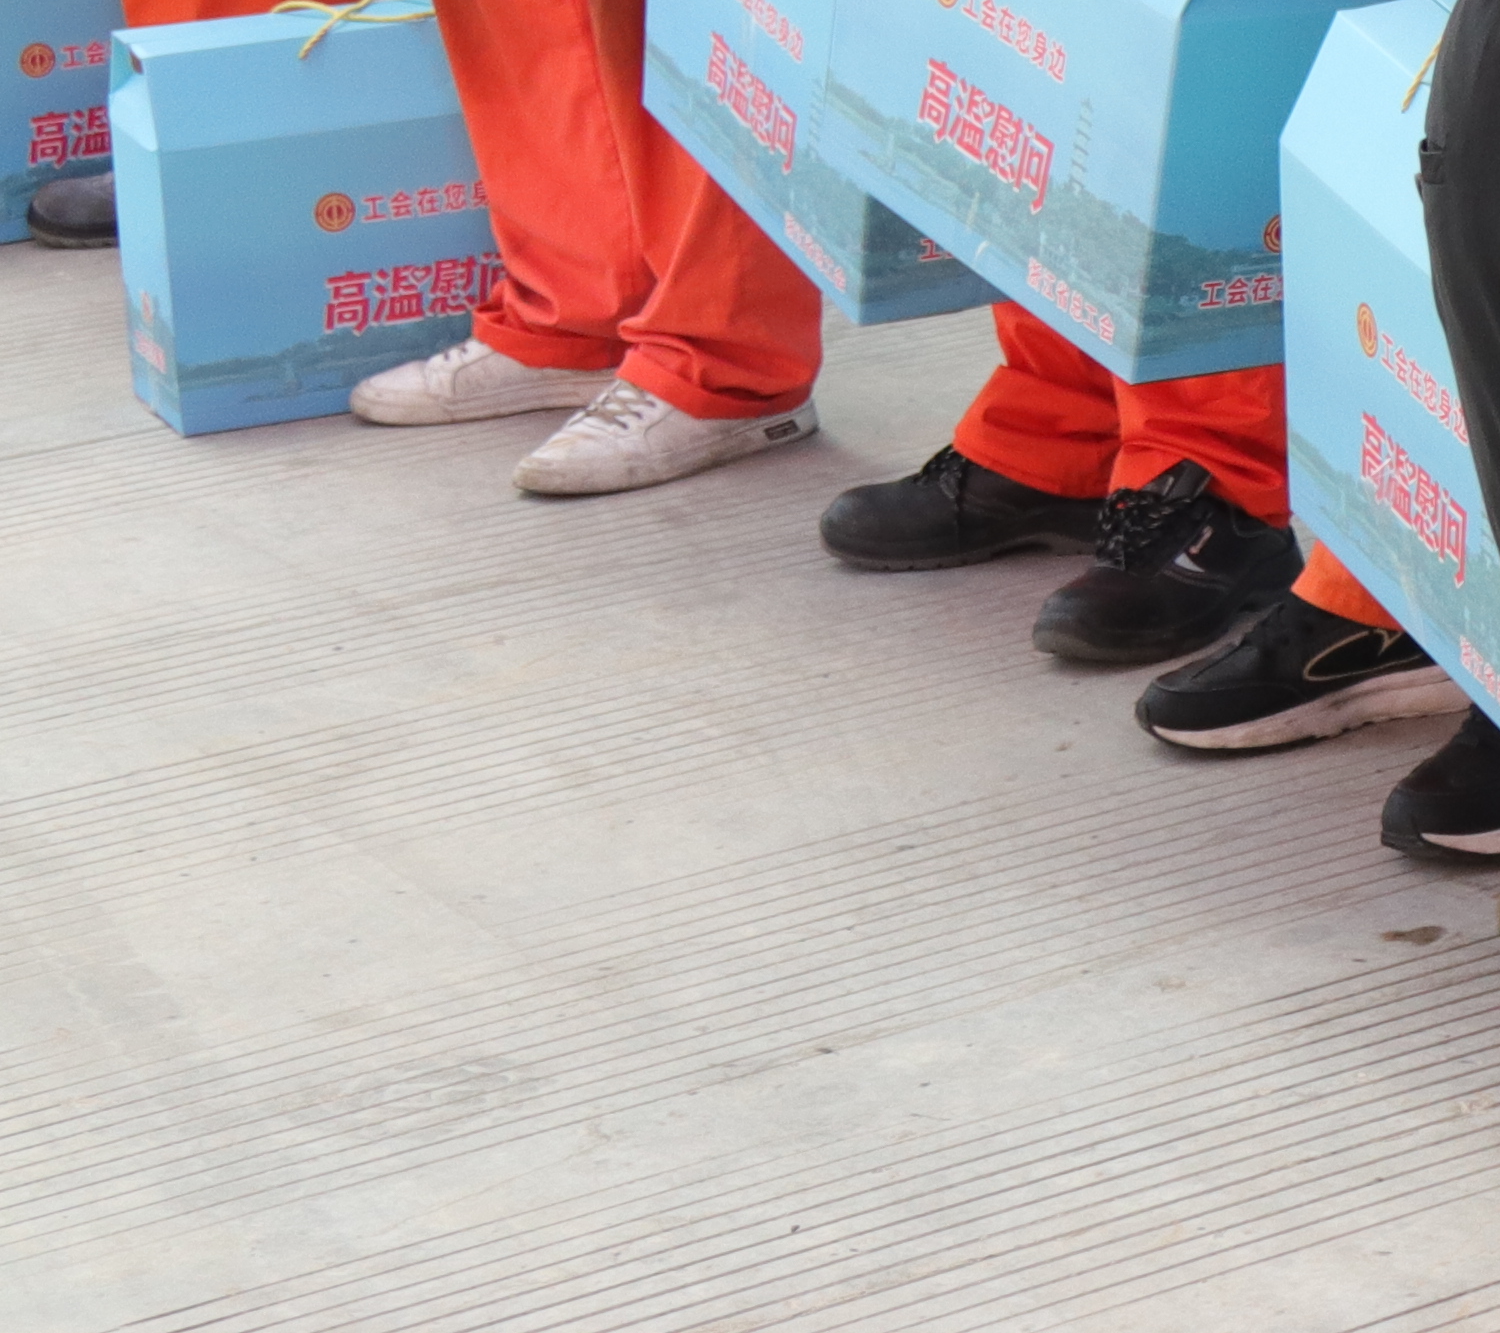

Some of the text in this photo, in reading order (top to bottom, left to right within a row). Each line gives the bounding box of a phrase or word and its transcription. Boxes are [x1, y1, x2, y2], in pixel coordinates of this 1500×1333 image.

[706, 30, 798, 176] 高温慰问
[917, 56, 1055, 216] 高温慰问
[1026, 256, 1116, 344] 浙江省总工会
[1199, 274, 1283, 309] 工会在
[1360, 410, 1470, 589] 高温慰问
